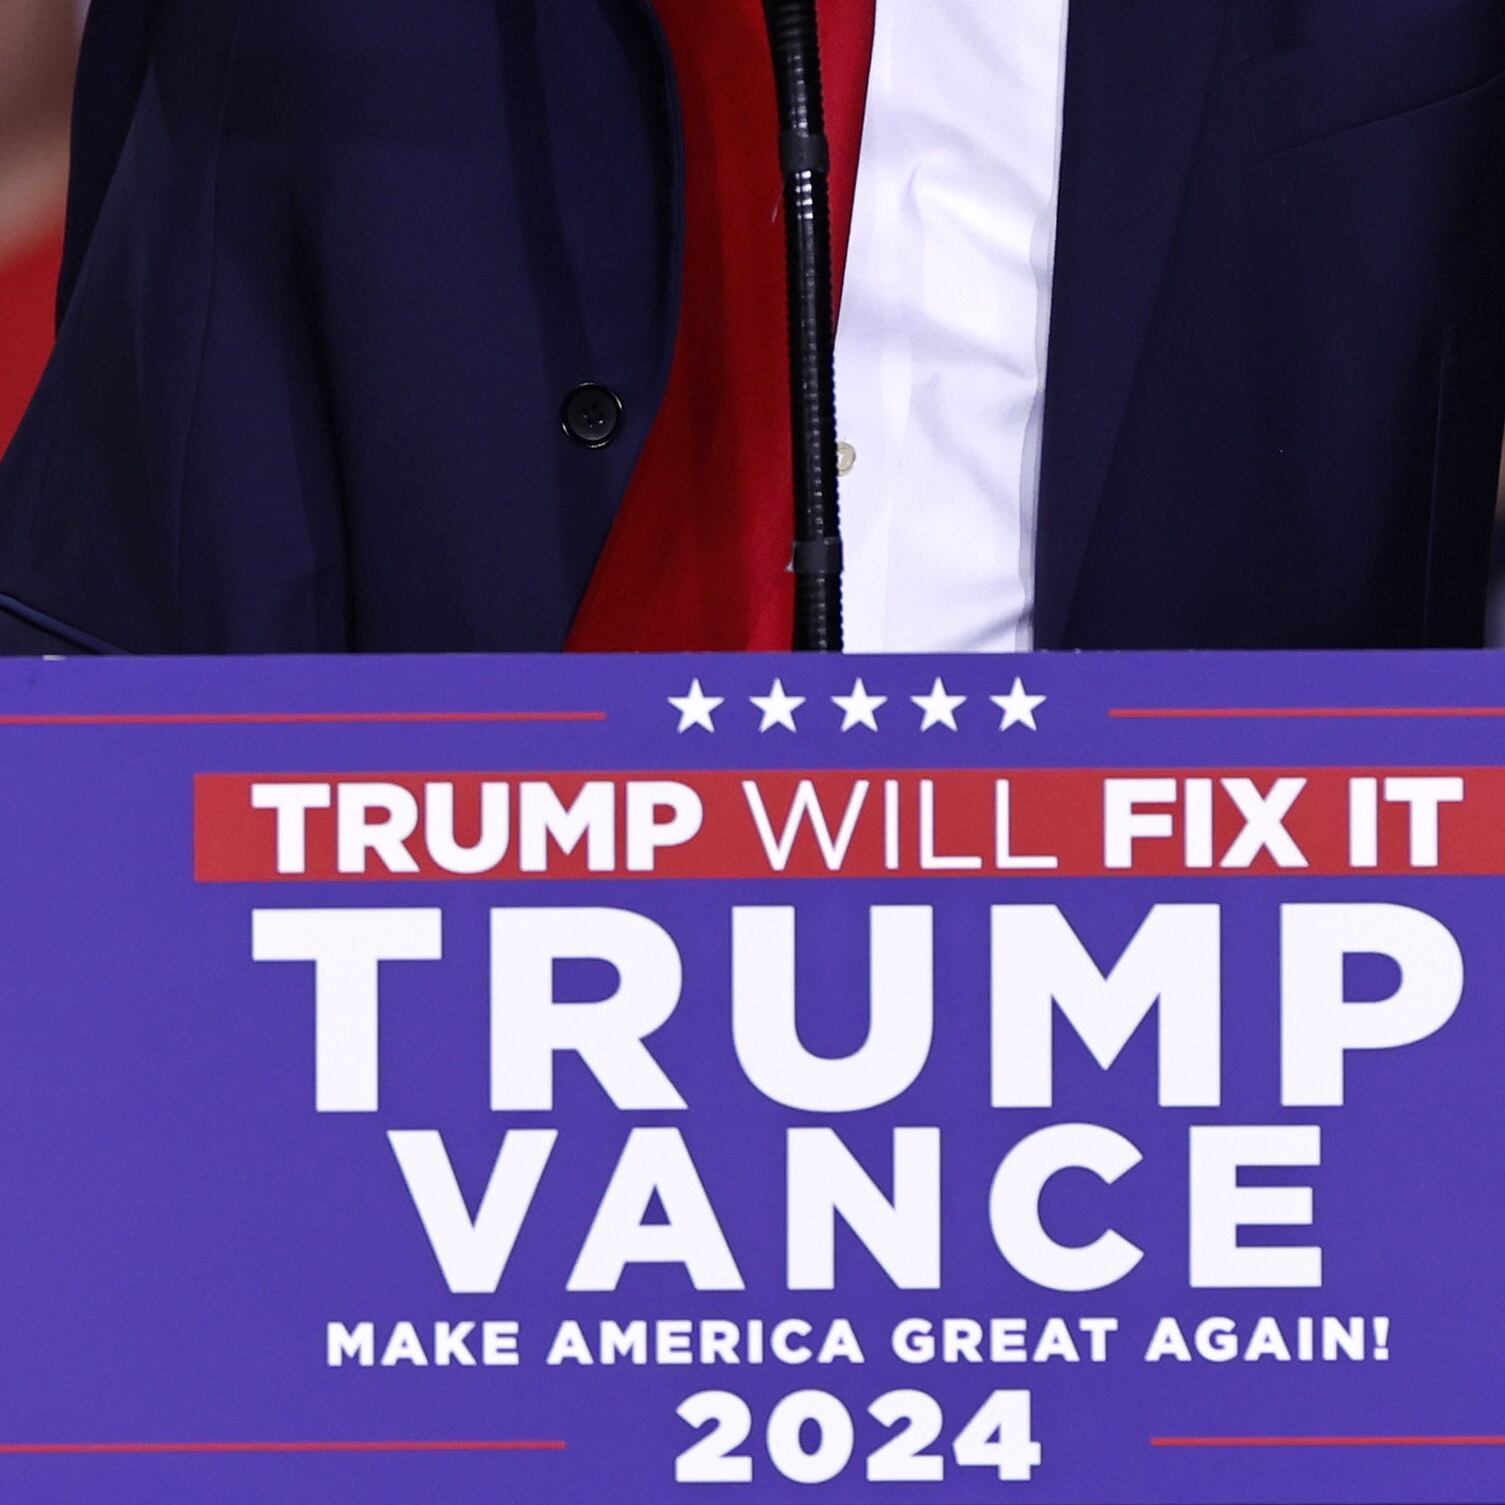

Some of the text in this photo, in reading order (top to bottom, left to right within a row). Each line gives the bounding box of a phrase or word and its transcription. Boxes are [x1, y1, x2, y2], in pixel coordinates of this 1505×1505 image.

[251, 776, 1465, 875] TRUMP WILL FIX IT
[251, 902, 1465, 1113] TRUMP
[386, 1122, 1323, 1294] VANCE
[326, 1315, 1390, 1367] MAKE AMERICA GREAT AGAIN!
[674, 1388, 1042, 1484] 2024
